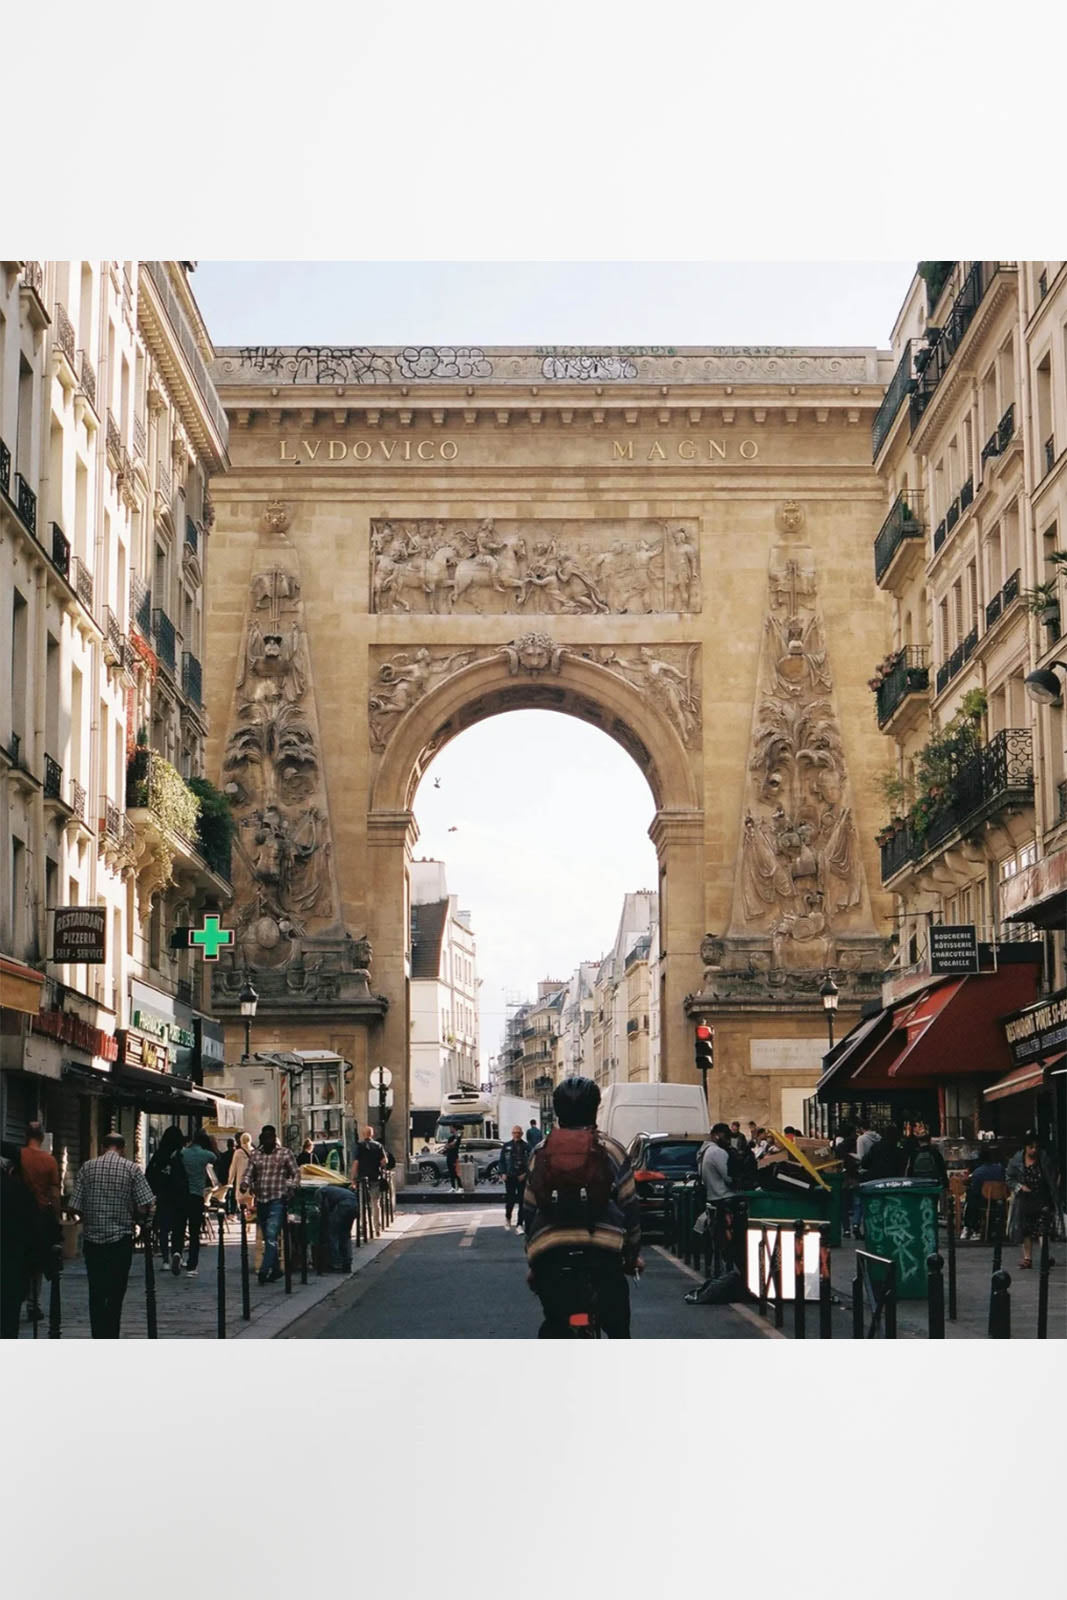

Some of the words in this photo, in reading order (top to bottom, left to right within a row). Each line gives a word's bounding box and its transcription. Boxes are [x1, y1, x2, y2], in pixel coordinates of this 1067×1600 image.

[279, 440, 458, 460] LVDOVICO
[611, 439, 760, 460] MAGNO
[56, 911, 104, 933] RESTAURANT
[63, 931, 96, 945] PIZZERIA
[934, 932, 971, 940] BOUCHERIE
[931, 950, 976, 958] CHARCUTERIE
